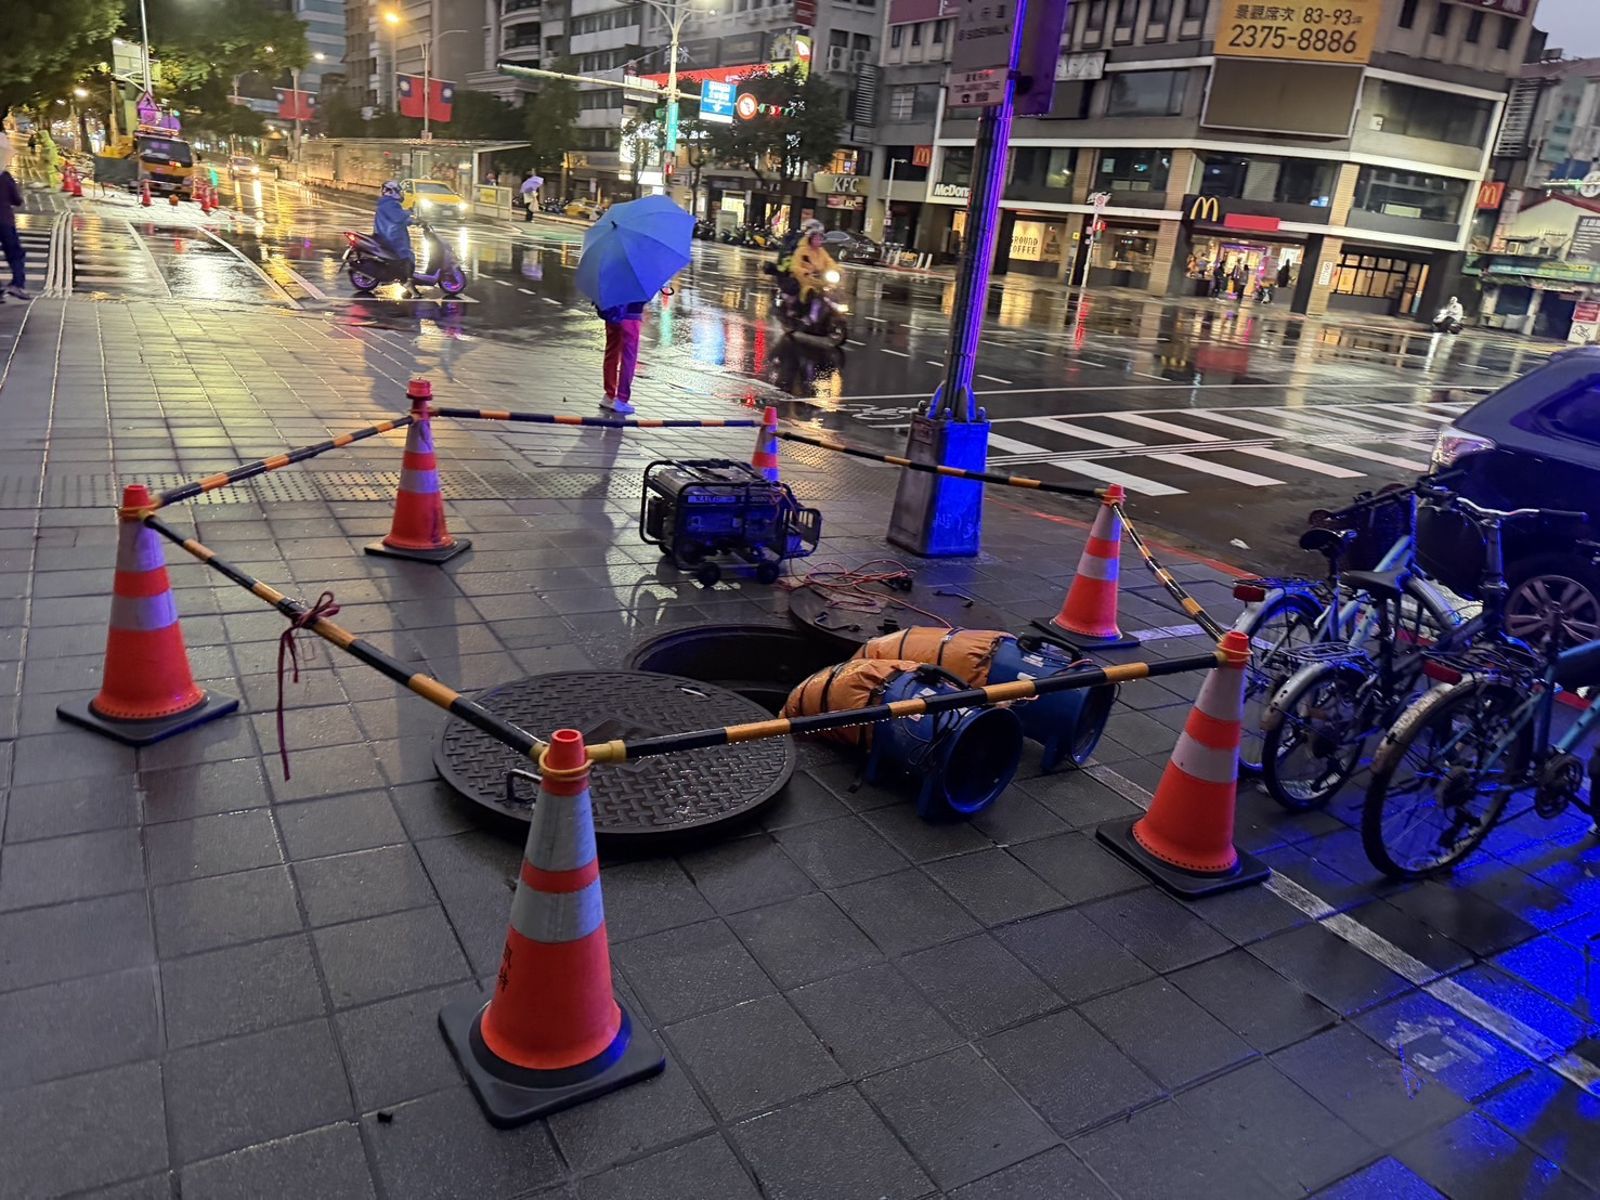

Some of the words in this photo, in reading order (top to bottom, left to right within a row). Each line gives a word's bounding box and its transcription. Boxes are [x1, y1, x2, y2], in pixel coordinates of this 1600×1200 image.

[1228, 24, 1357, 54] 2375-8886
[832, 177, 859, 193] KFC
[1013, 235, 1039, 246] ROUND
[1012, 245, 1037, 255] OFFEE
